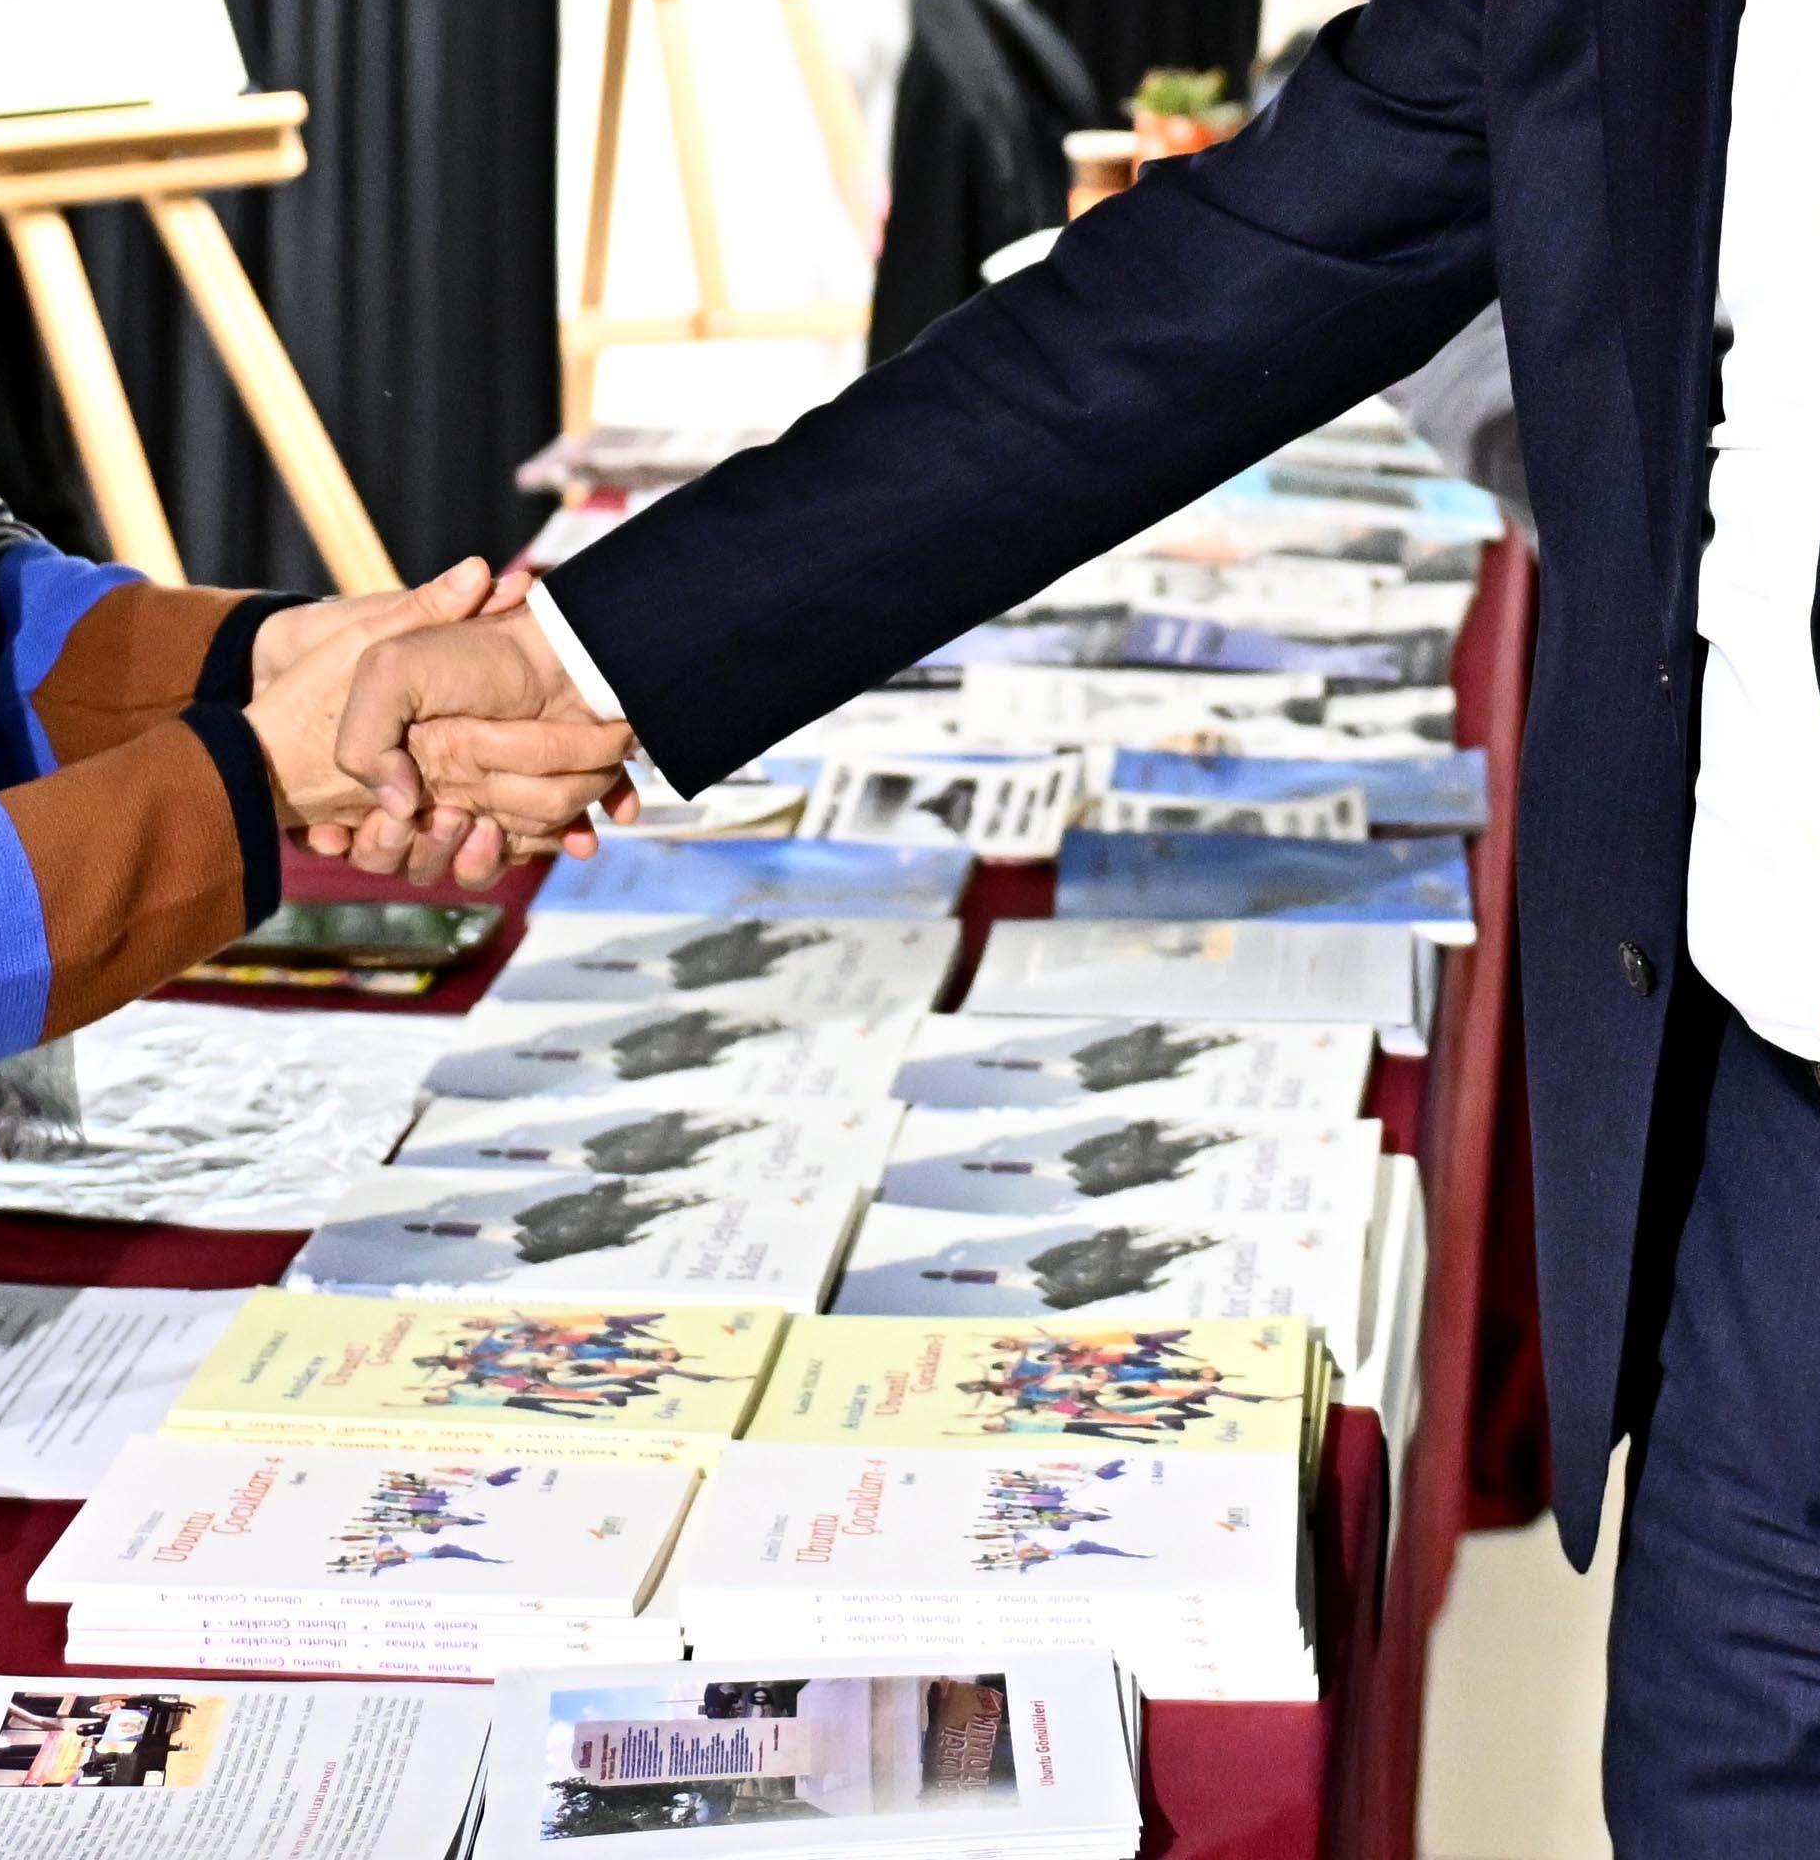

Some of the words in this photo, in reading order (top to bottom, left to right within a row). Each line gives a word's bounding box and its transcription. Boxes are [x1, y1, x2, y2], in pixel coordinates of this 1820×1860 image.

[153, 1512, 216, 1562] Ubuntu
[795, 1513, 840, 1563] Ubuntu
[1030, 1699, 1051, 1753] Gönüllüleri
[1039, 1755, 1054, 1787] Ubuntu
